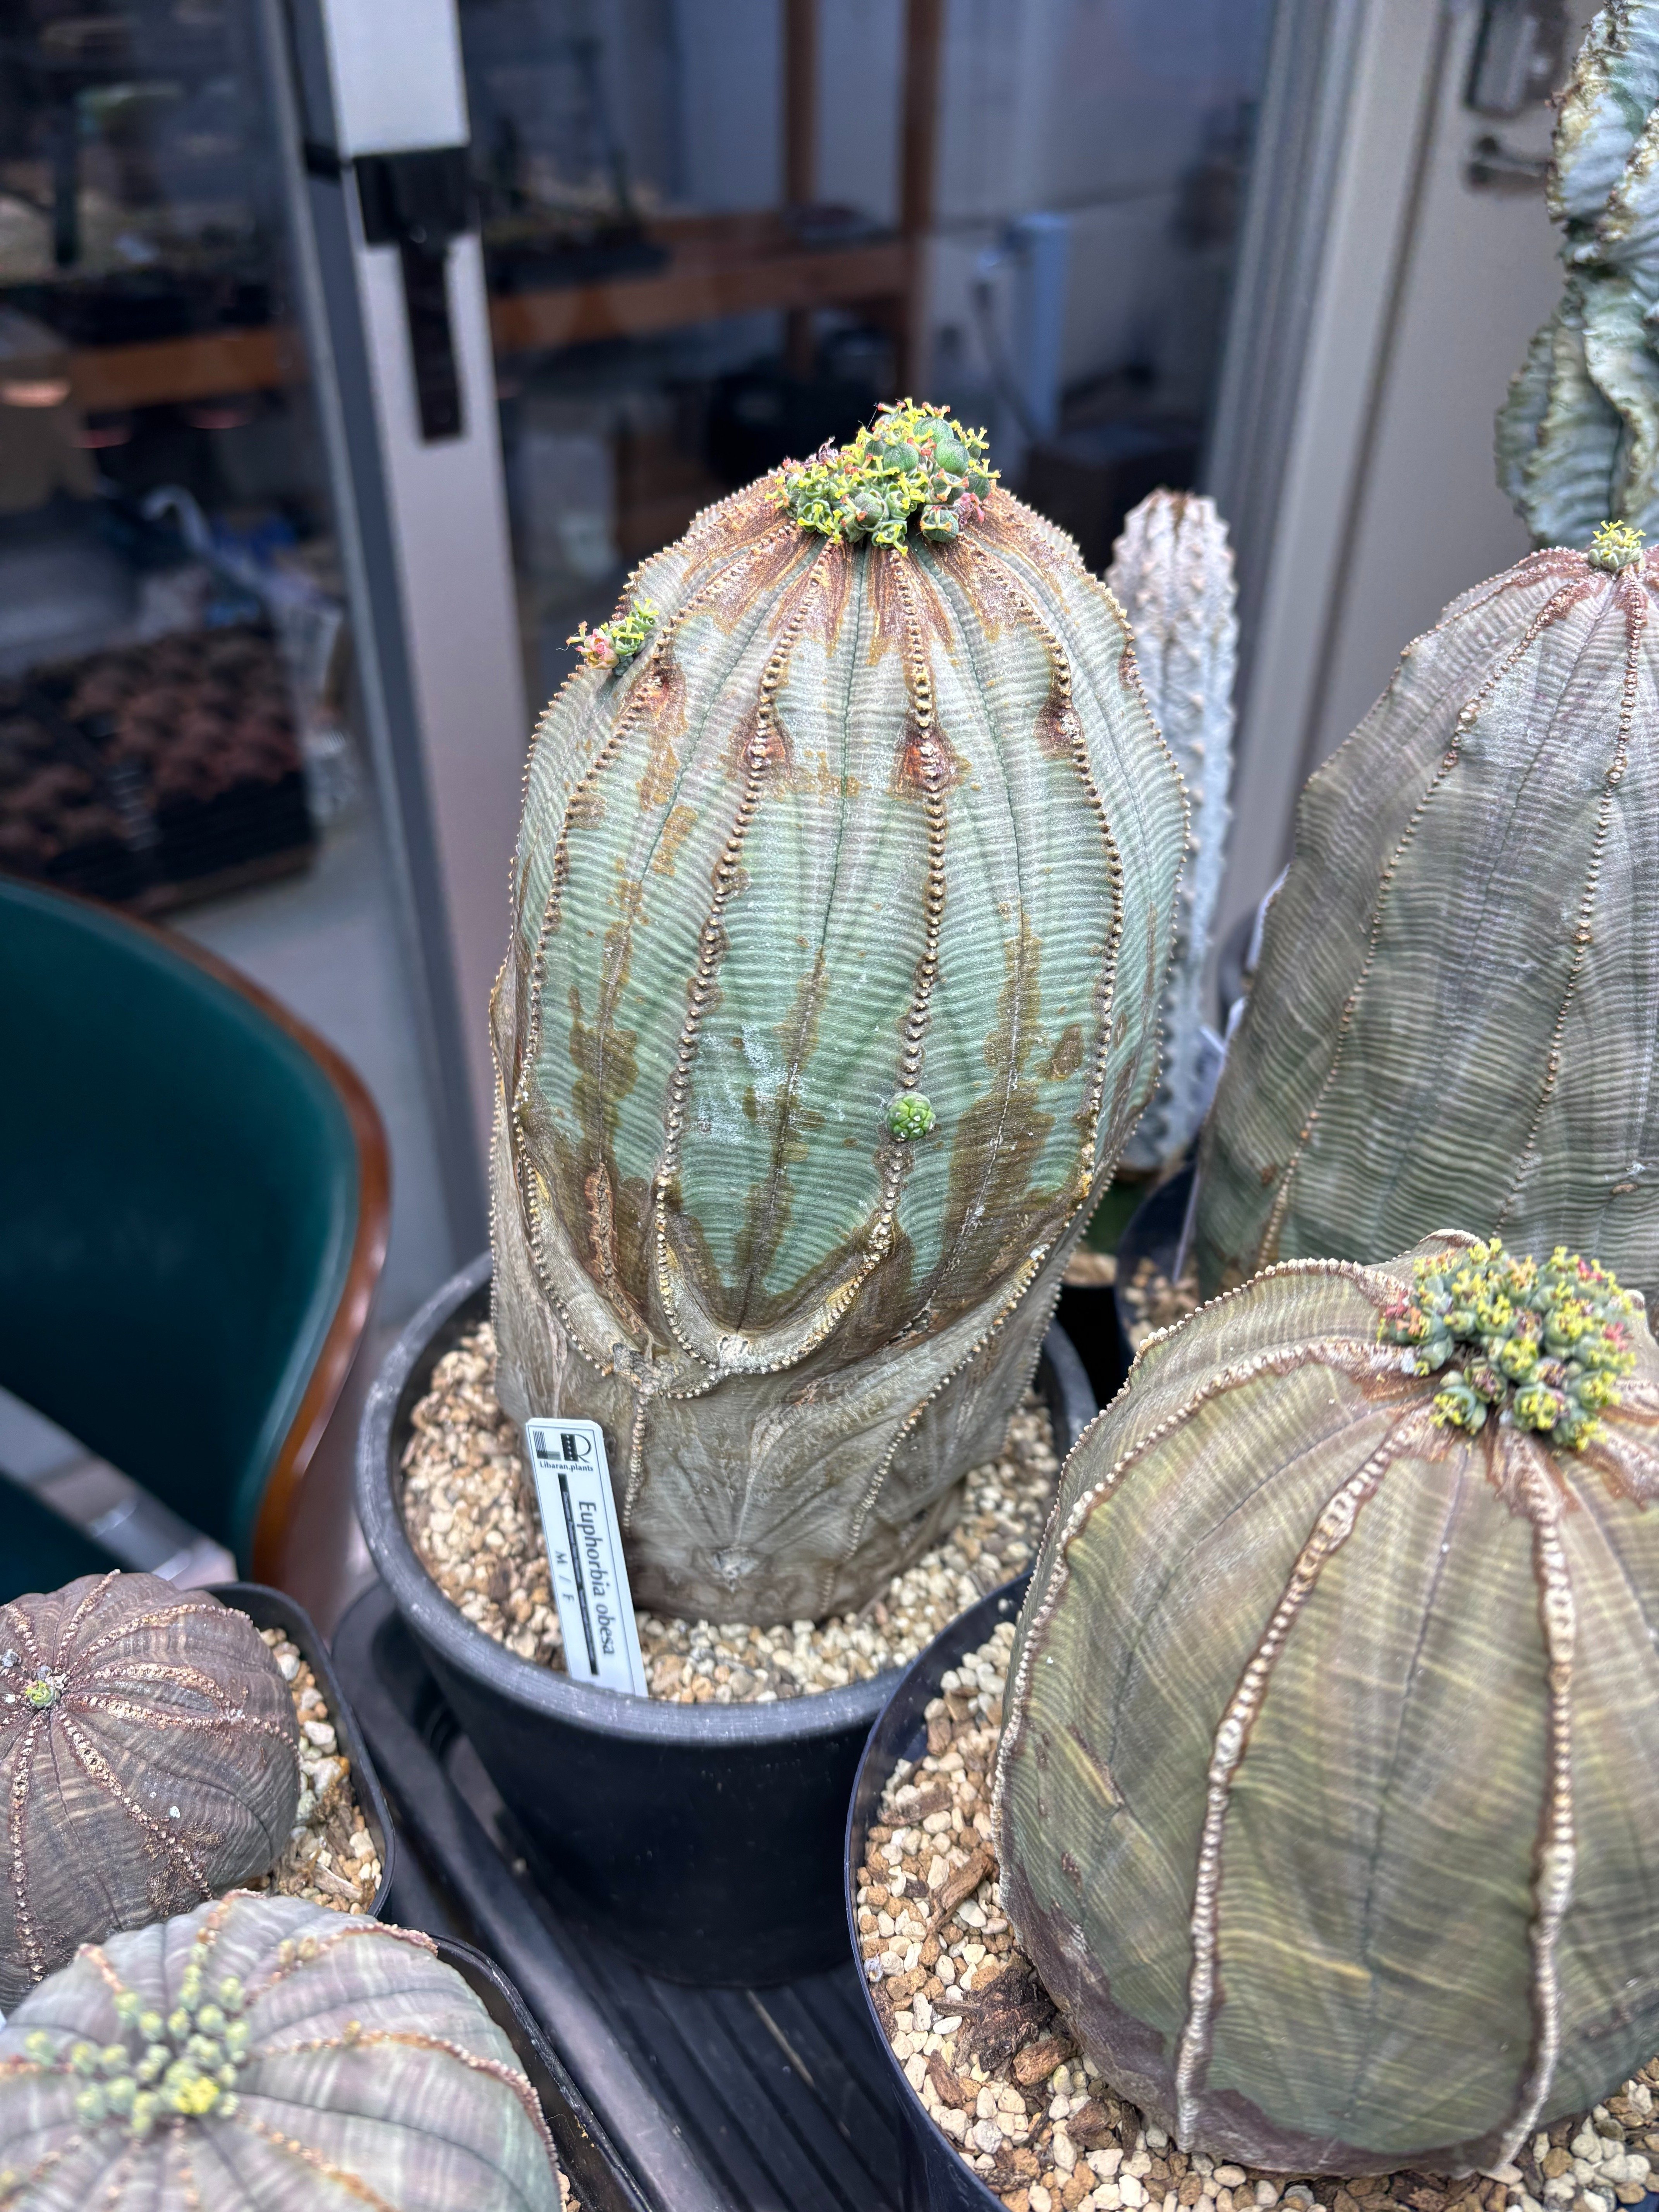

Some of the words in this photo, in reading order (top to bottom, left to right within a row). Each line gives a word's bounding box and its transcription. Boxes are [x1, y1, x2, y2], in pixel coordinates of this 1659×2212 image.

[540, 1461, 594, 1472] Libaran.plants
[555, 1551, 568, 1564] M
[562, 1593, 575, 1601] F
[577, 1501, 610, 1596] Euphorbia
[596, 1604, 616, 1655] obesa
